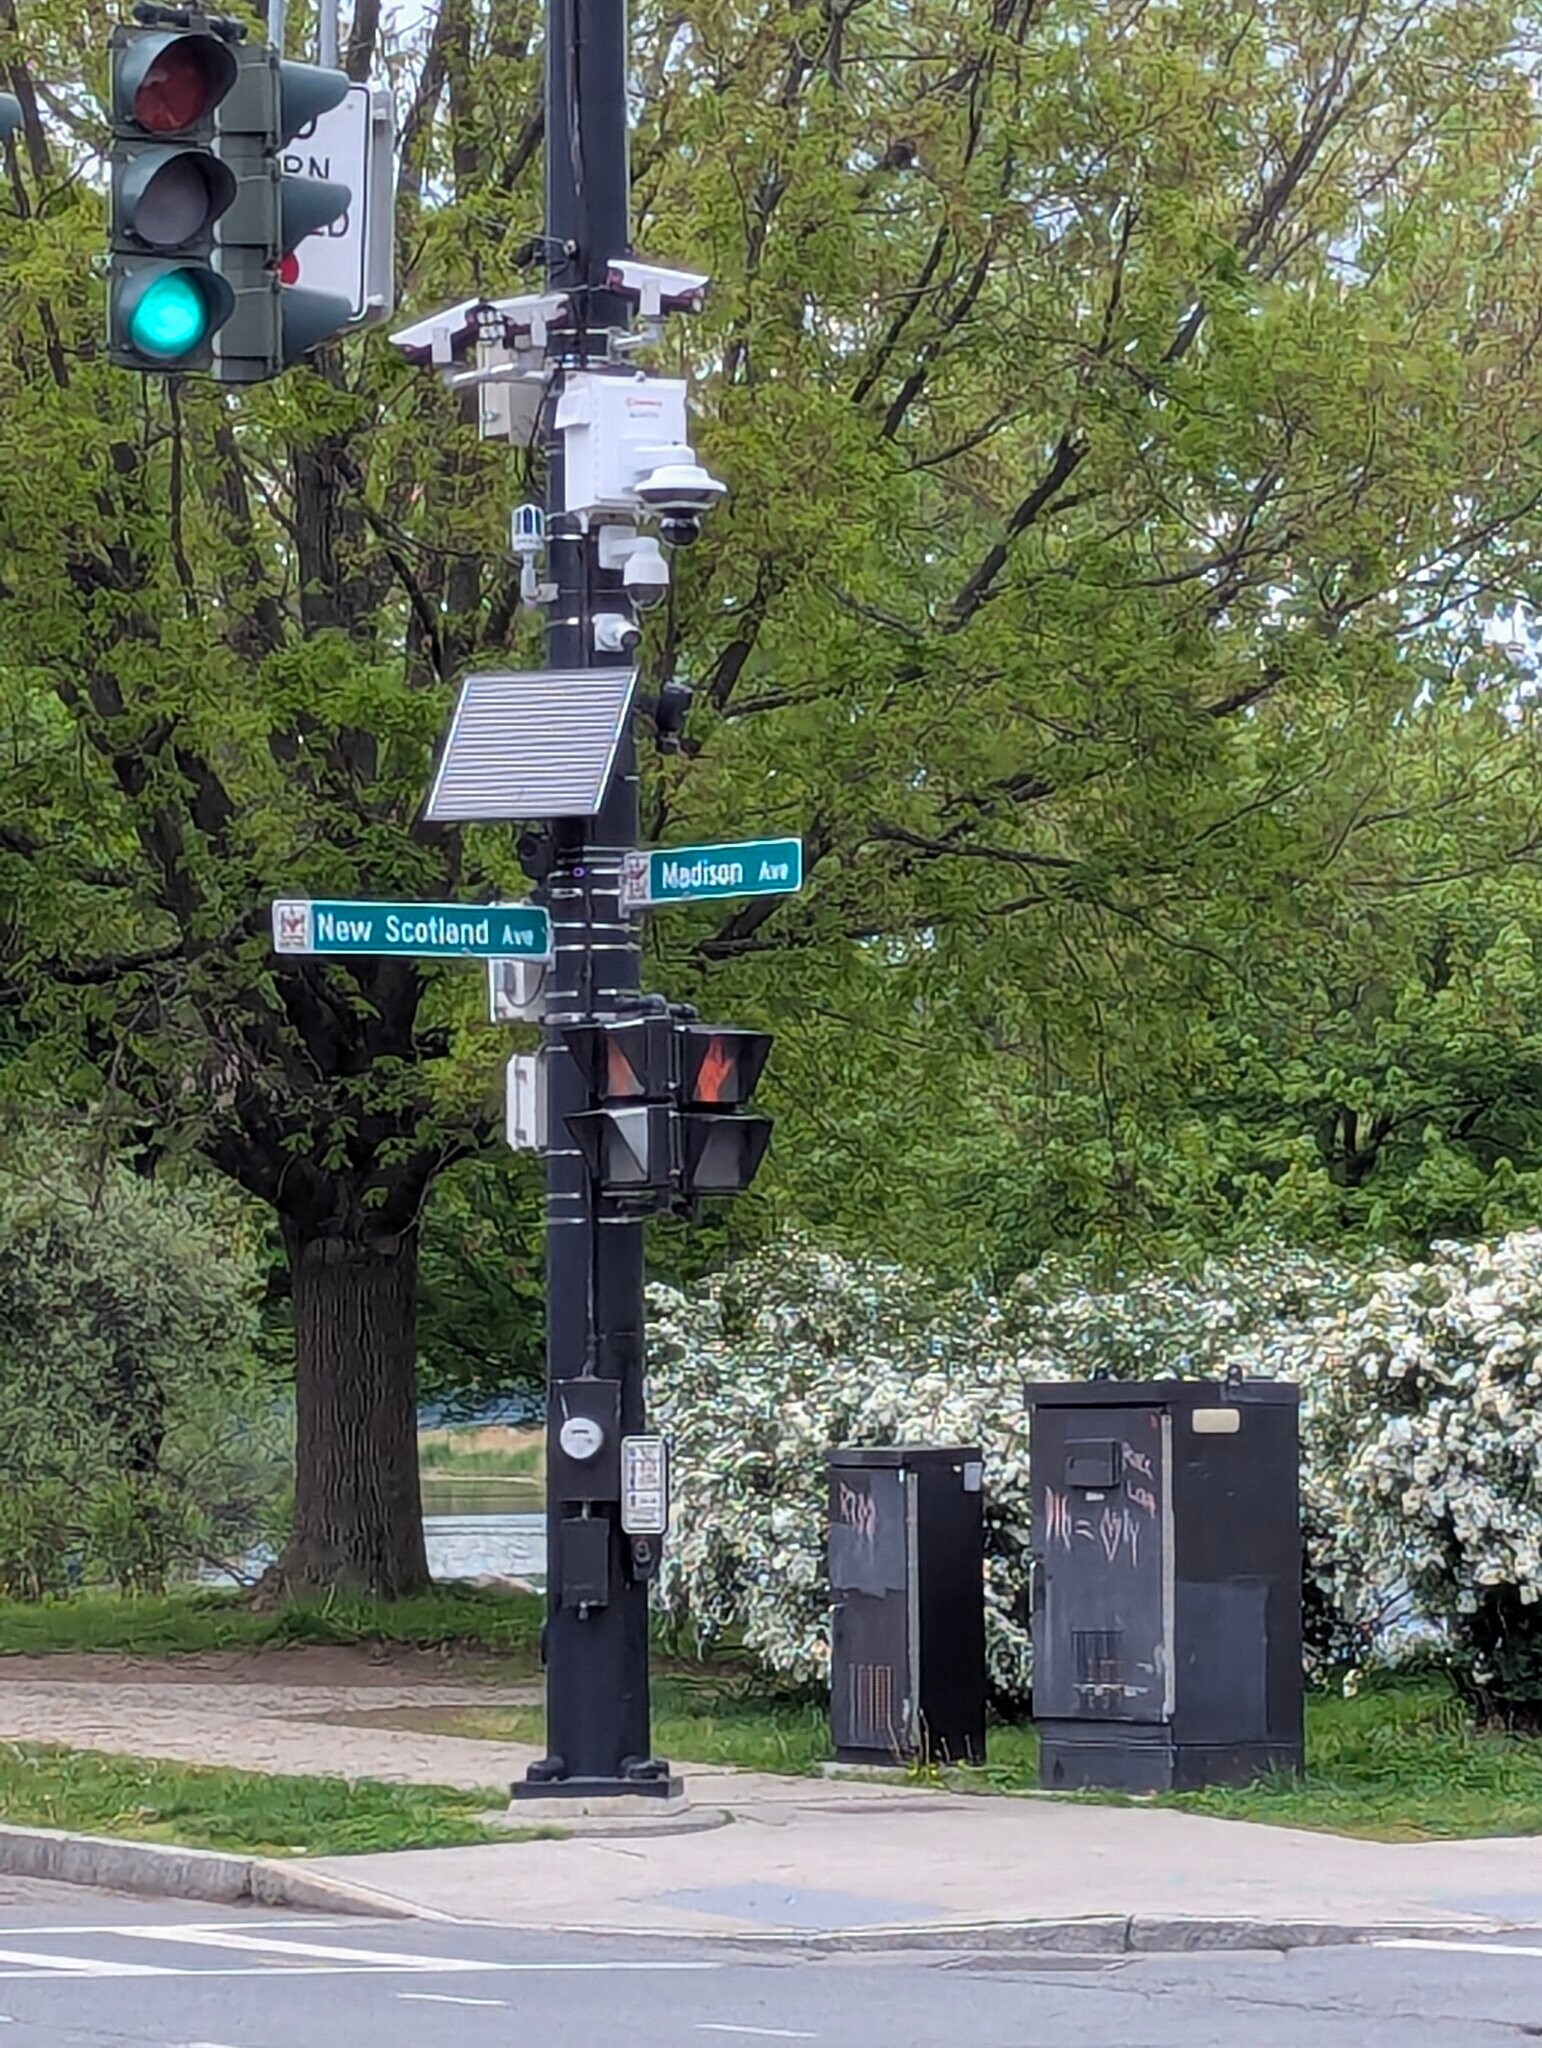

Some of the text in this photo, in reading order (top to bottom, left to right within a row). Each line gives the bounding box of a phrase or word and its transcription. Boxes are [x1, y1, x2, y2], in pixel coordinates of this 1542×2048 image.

[662, 859, 743, 889] Madison
[758, 859, 789, 882] Ave
[317, 912, 534, 946] New Scotland Ave
